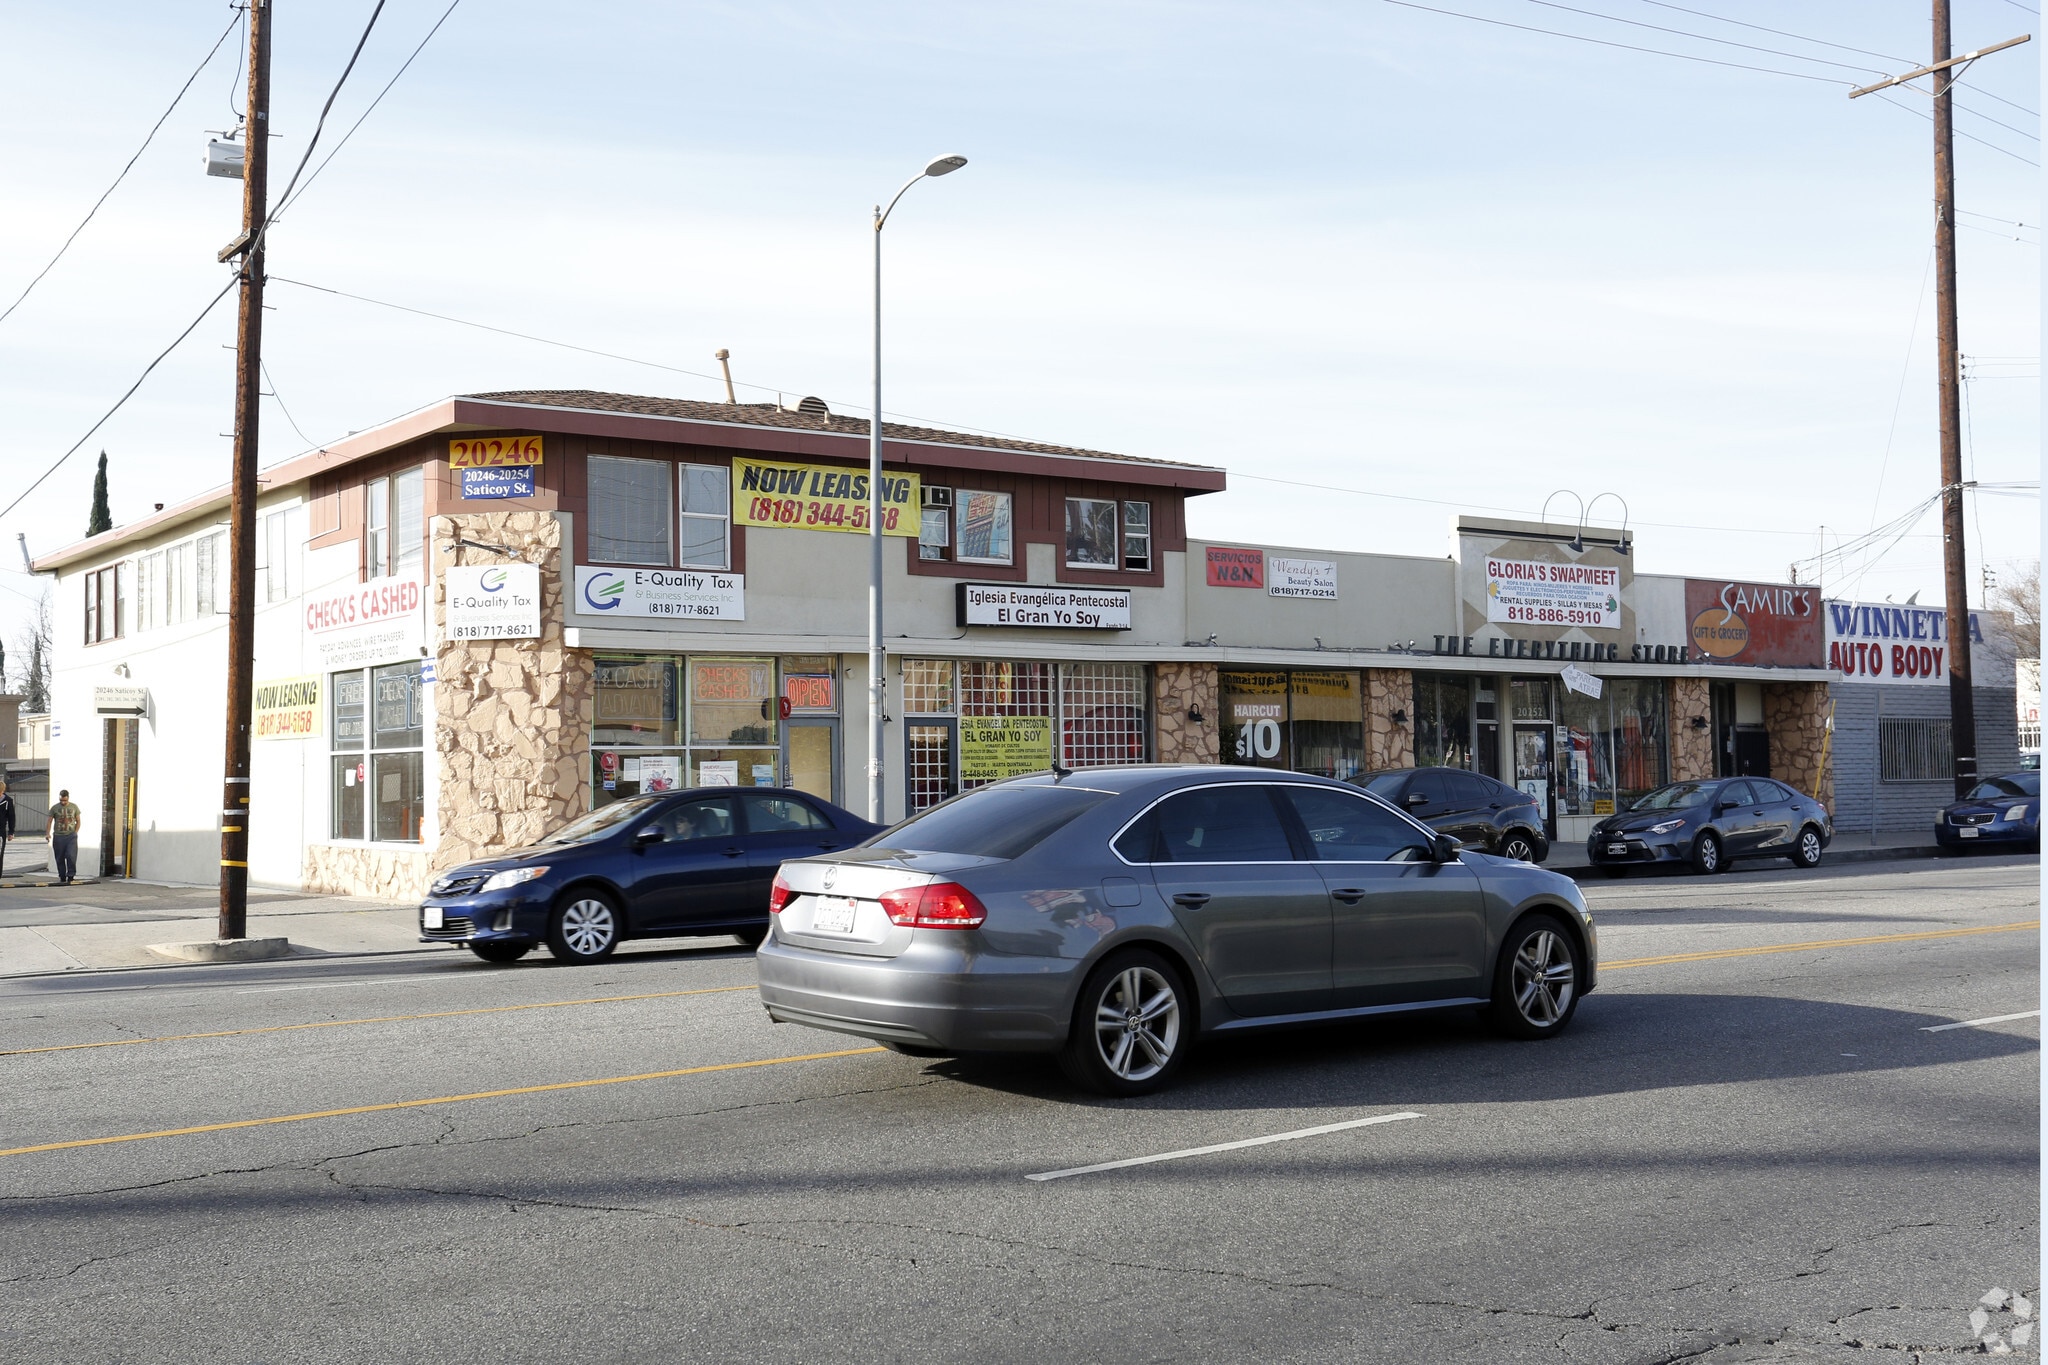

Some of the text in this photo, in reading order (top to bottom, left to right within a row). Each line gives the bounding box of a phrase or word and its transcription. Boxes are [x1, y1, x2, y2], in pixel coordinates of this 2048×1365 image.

[454, 438, 539, 467] 20246
[465, 469, 530, 482] 20246-20254
[465, 483, 530, 497] Saticoy St.
[741, 466, 910, 504] NOW LEASNG
[749, 496, 803, 523] (818)
[1207, 552, 1261, 564] SERVICIOS
[1217, 565, 1254, 582] N&N
[1272, 559, 1320, 578] Wendy's
[1488, 561, 1616, 586] GLORIA'S SWAPMEET
[635, 572, 734, 590] E-Quality Tax
[1288, 577, 1334, 588] Beauty Salon
[635, 590, 734, 603] & Business Services Inc
[969, 590, 1128, 608] Iglesia Evangélica Pentecostal
[1271, 586, 1335, 597] (818)717-0214
[307, 581, 418, 630] CHECKS CASHED
[453, 595, 531, 609] E-Quality Tax
[649, 602, 720, 616] (818) 717-8621
[1500, 596, 1523, 605] RENTAL
[1524, 598, 1552, 606] SUPPLIES
[1557, 600, 1577, 608] SILLAS
[1719, 583, 1811, 626] SAMIR'S
[998, 608, 1101, 627] El Gran Yo Soy
[1508, 606, 1601, 625] 818-886-5910
[1830, 604, 1984, 643] WINNETA
[453, 624, 533, 639] (818) 717-8621
[1694, 625, 1749, 642] GIFT & GROCERY
[1433, 634, 1689, 664] THE EVERYTHING STORE
[1830, 641, 1944, 679] AUTO BODY
[615, 667, 658, 689] CASH
[663, 671, 671, 690] $
[698, 666, 748, 683] CHECKS
[114, 687, 136, 696] Saticoy
[256, 681, 317, 710] NOW LEASING
[698, 683, 750, 699] CASHED
[787, 678, 831, 706] OPEN
[1234, 705, 1281, 717] HAIRCUT
[1517, 707, 1542, 717] 20252
[258, 710, 313, 735] (818) 344-5158
[1012, 719, 1048, 729] PENTECOSTAL
[965, 731, 1042, 742] EL GRAN YO SOY
[1235, 718, 1281, 758] $10
